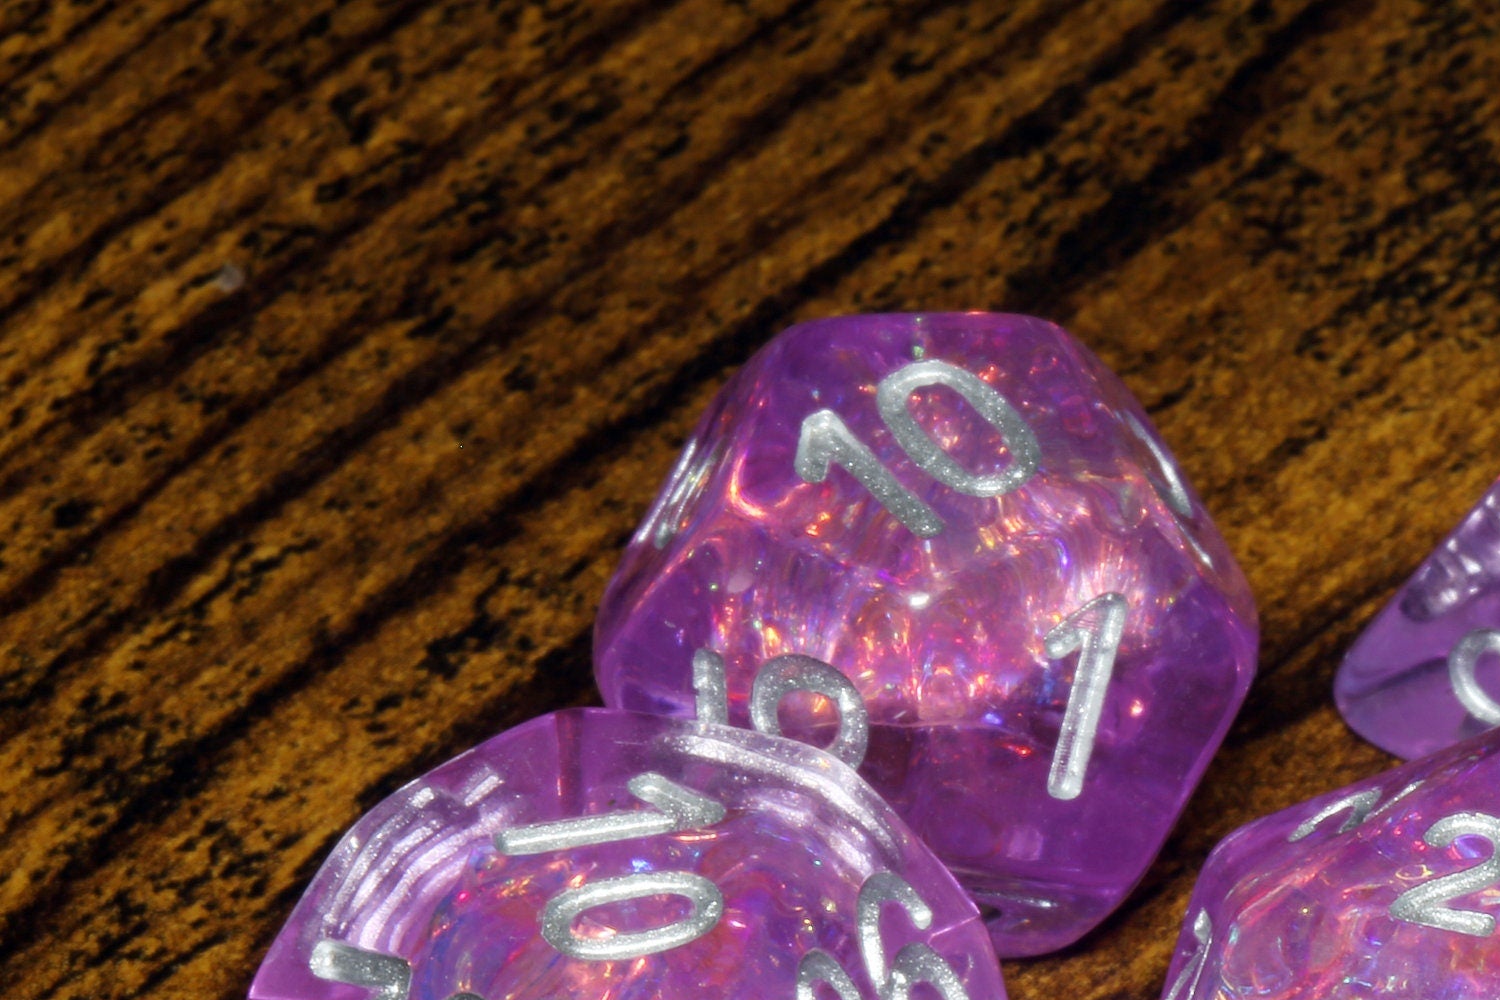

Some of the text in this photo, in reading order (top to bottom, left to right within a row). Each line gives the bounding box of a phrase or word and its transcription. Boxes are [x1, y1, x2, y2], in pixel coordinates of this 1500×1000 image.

[795, 359, 1041, 538] 10
[1045, 592, 1128, 799] 1
[494, 773, 725, 961] 10
